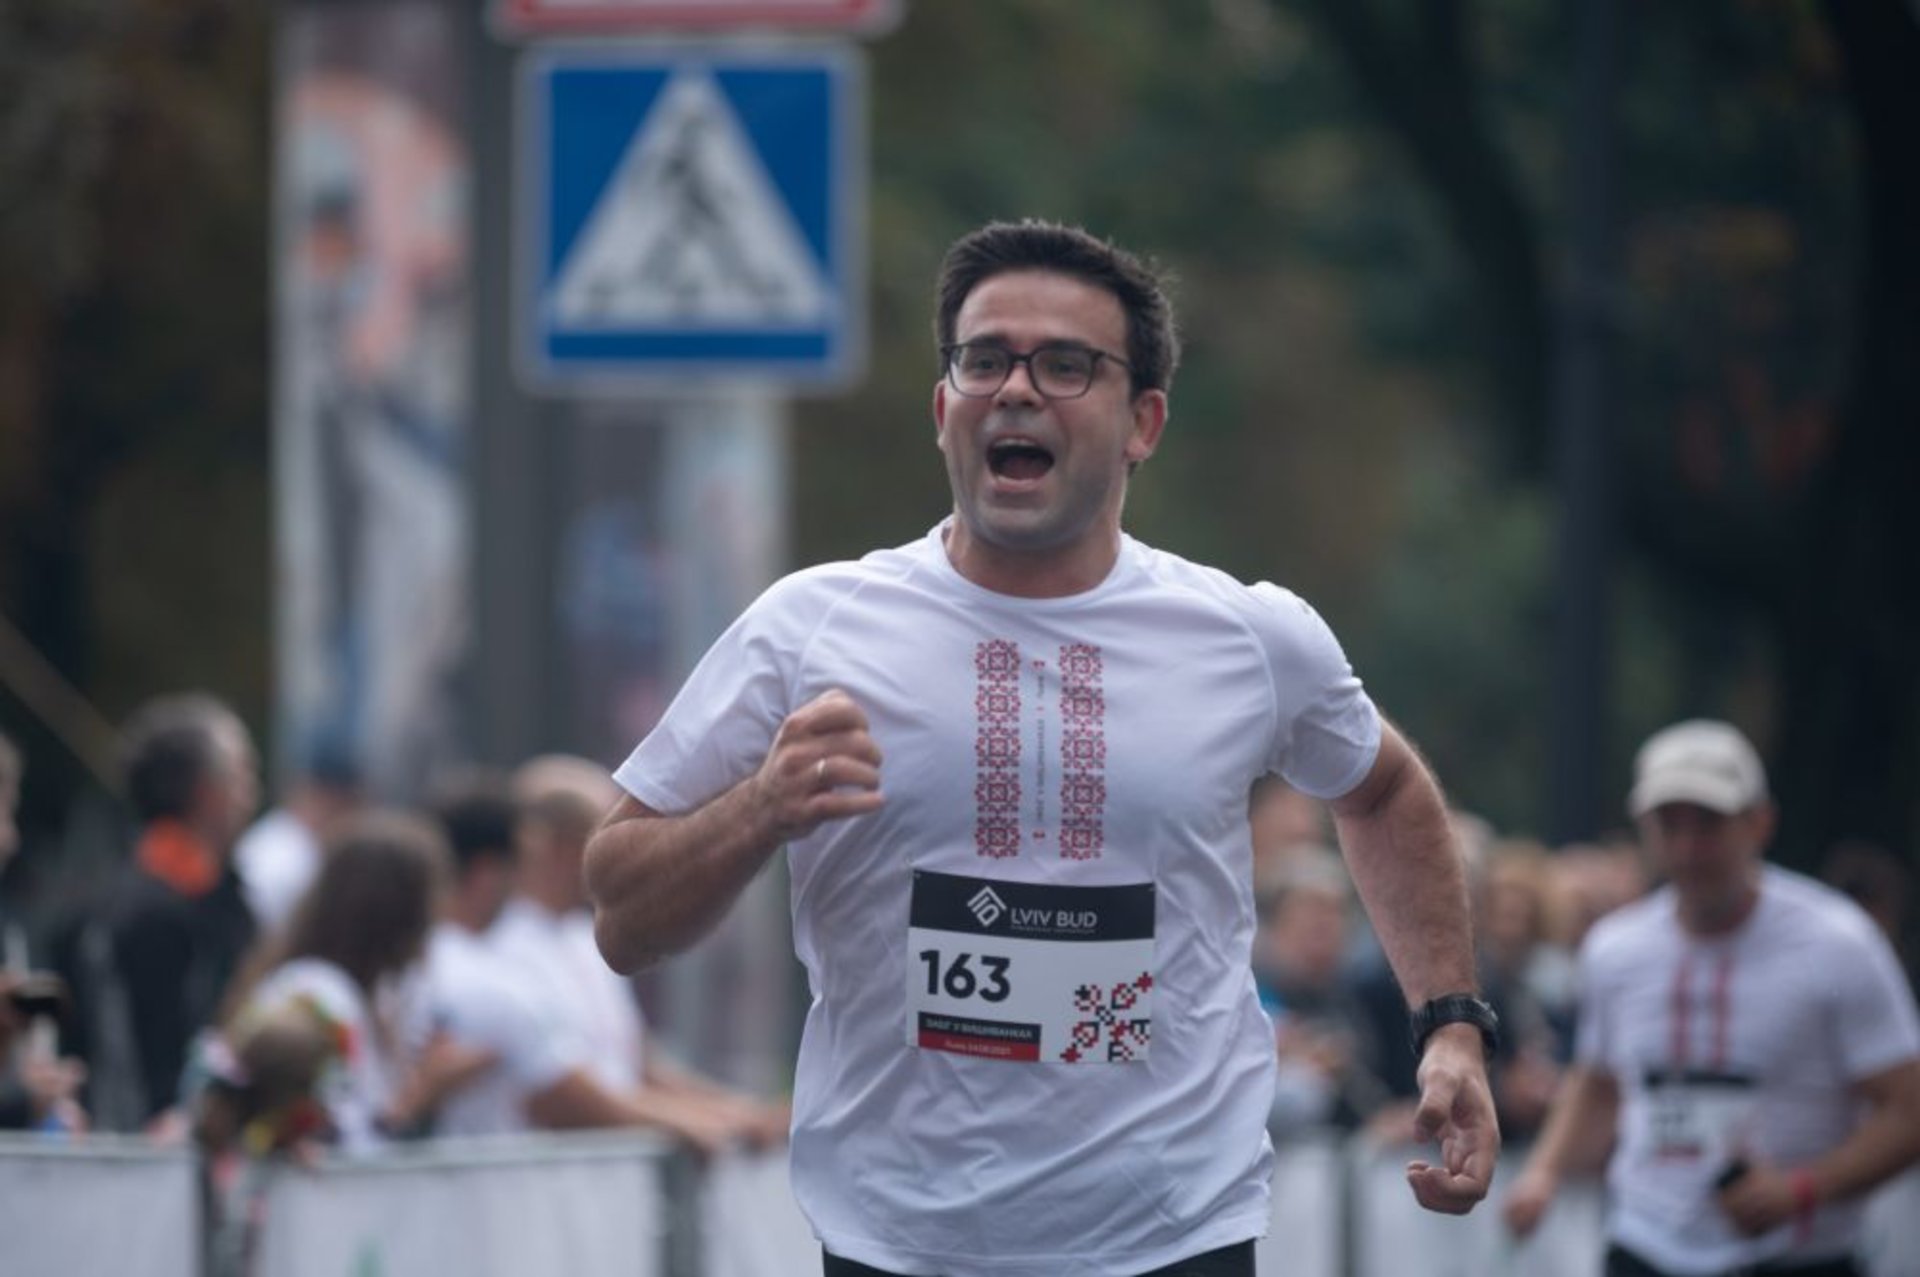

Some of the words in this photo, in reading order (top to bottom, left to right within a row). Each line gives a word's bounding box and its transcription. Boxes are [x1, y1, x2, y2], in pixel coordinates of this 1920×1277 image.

[1010, 907, 1052, 926] LVIV
[1056, 910, 1098, 928] BUD
[919, 949, 1011, 1003] 163
